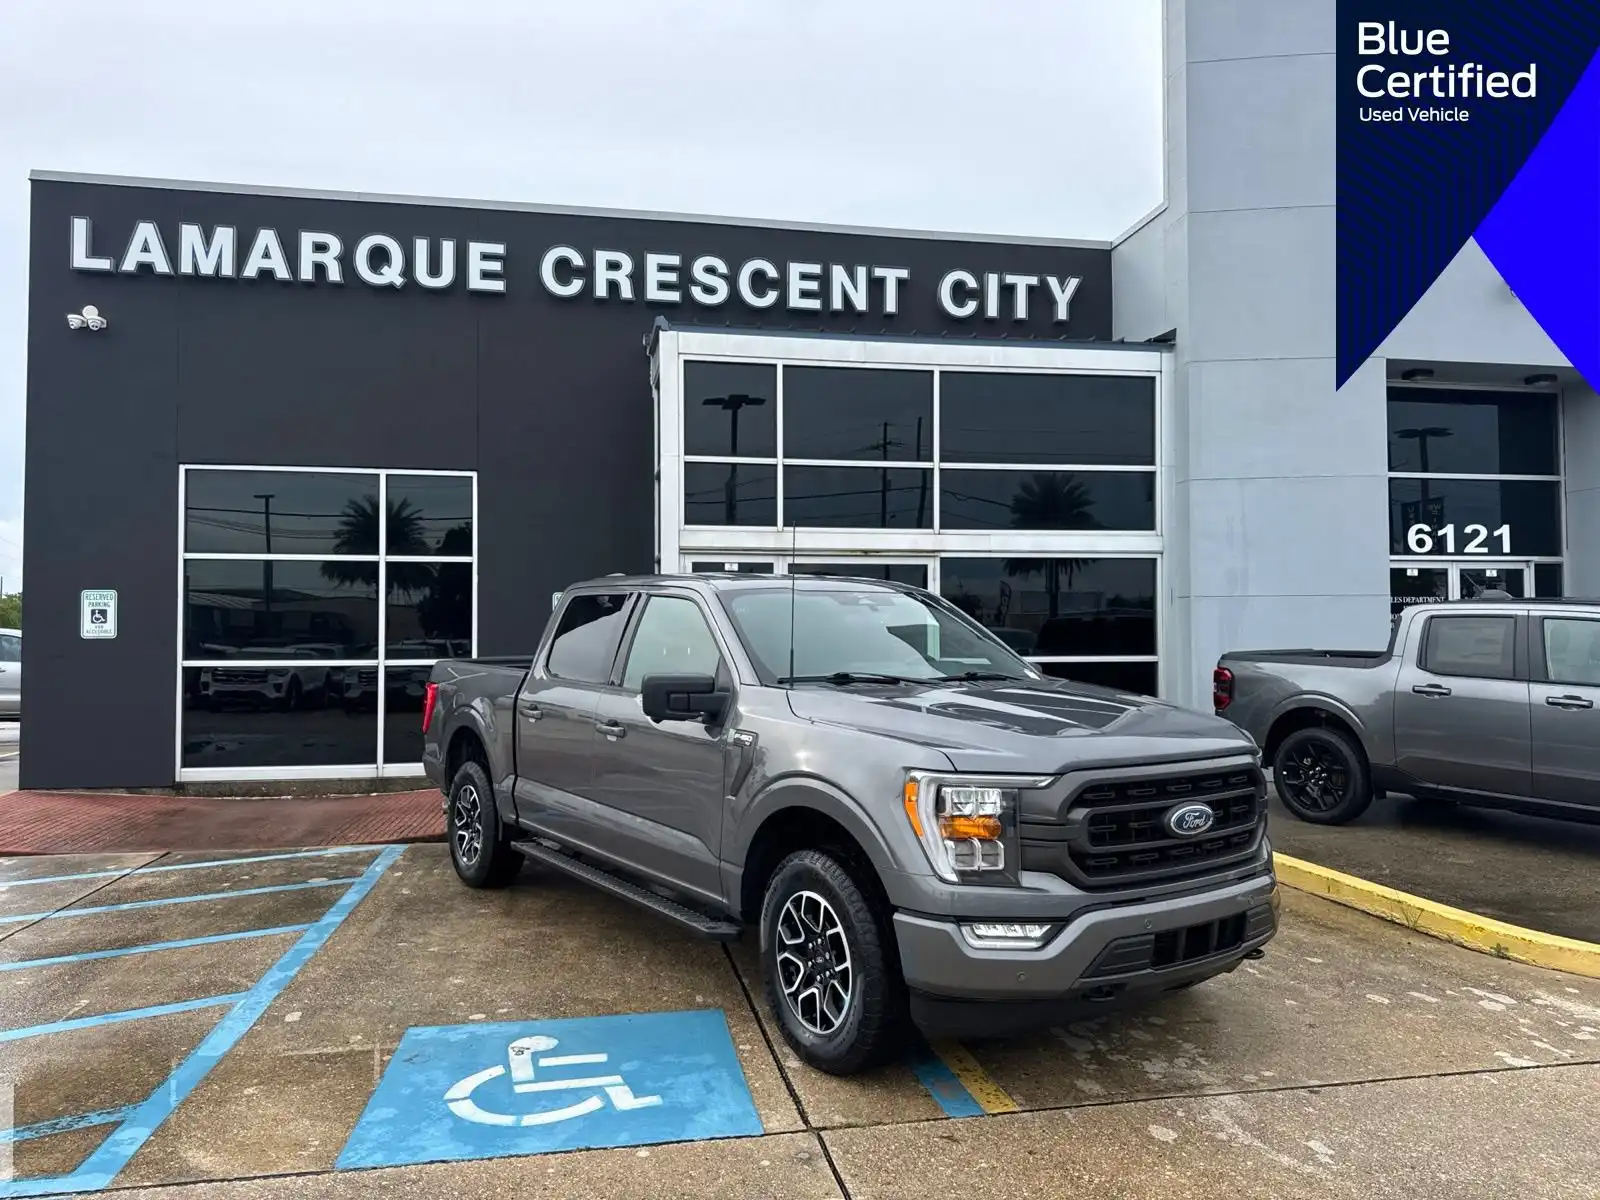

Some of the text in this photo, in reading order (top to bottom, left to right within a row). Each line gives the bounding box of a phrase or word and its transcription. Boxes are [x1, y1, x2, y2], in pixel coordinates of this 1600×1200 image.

[70, 216, 1083, 322] LAMARQUE CRESCENT CITY
[1407, 523, 1511, 554] 6121
[1182, 812, 1206, 828] Ford
